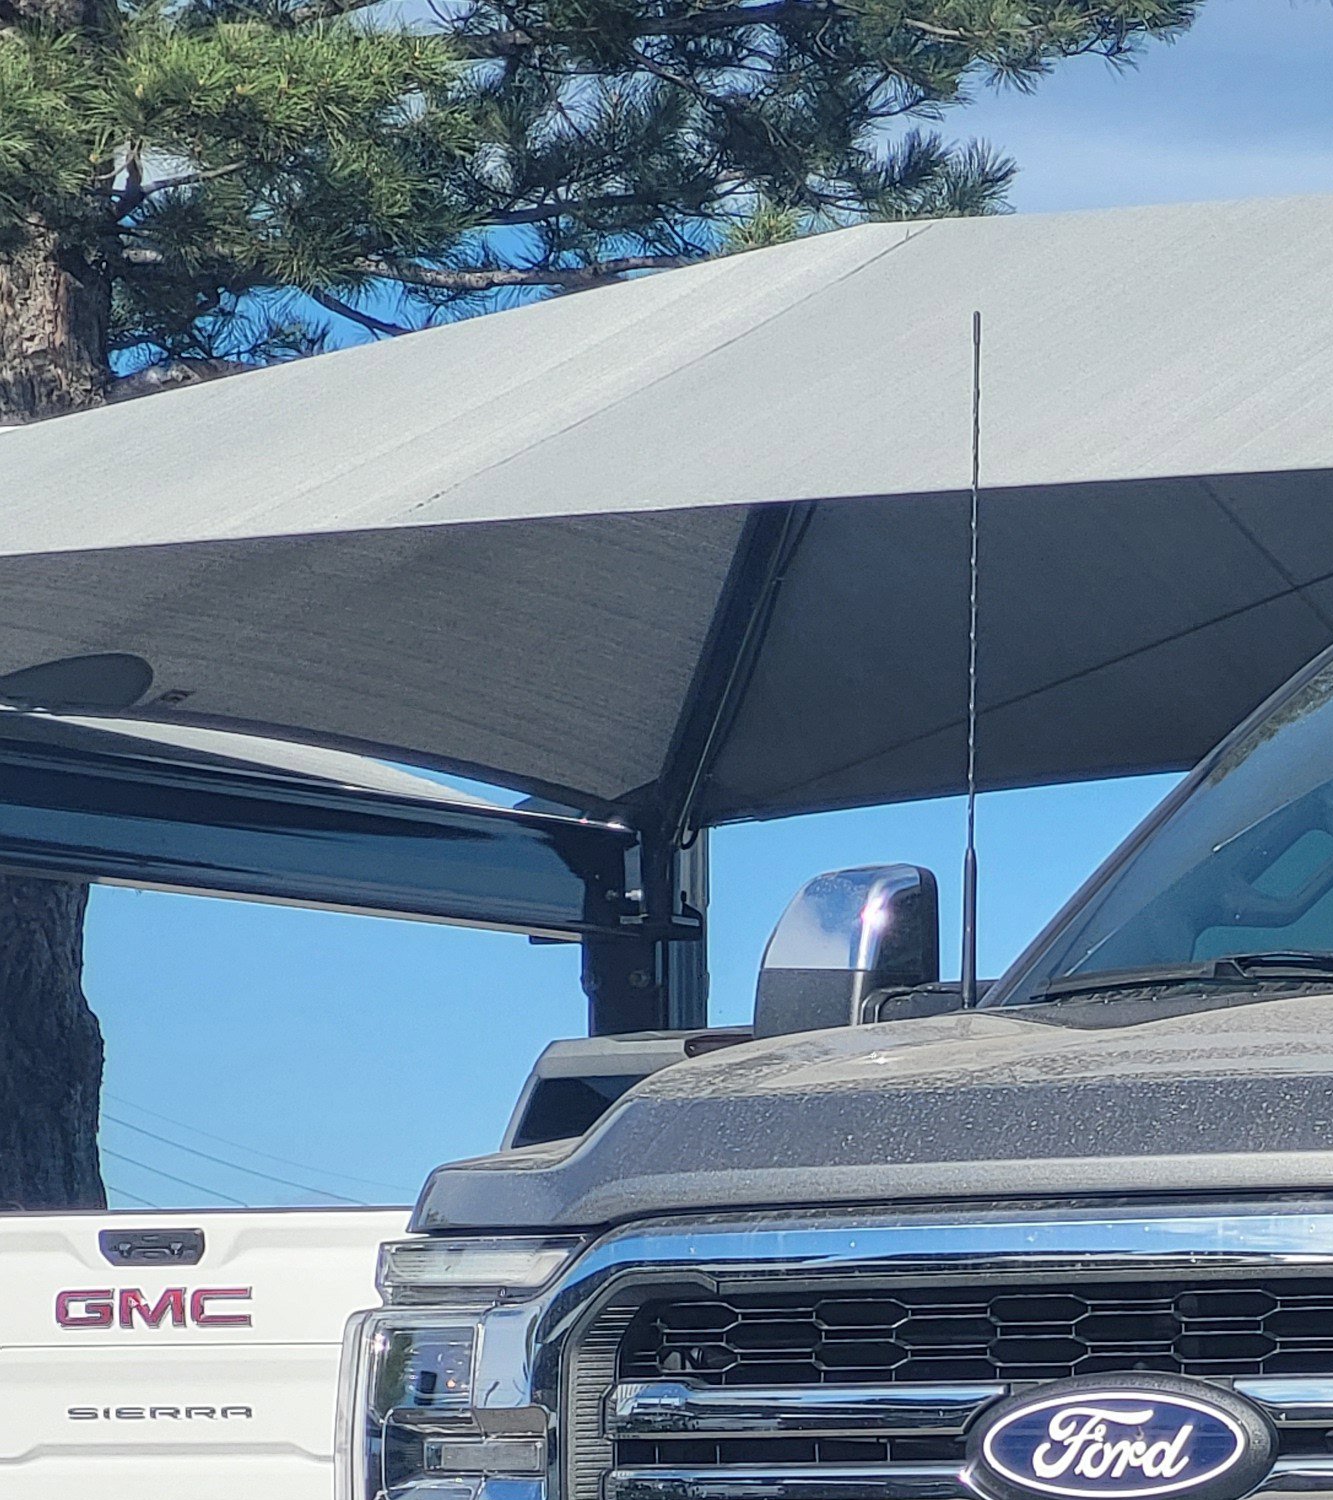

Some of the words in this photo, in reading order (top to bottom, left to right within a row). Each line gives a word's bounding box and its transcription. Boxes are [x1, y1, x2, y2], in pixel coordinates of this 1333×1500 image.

[55, 1287, 252, 1329] GMC
[67, 1406, 253, 1420] SIERRA
[1032, 1406, 1194, 1478] Ford
